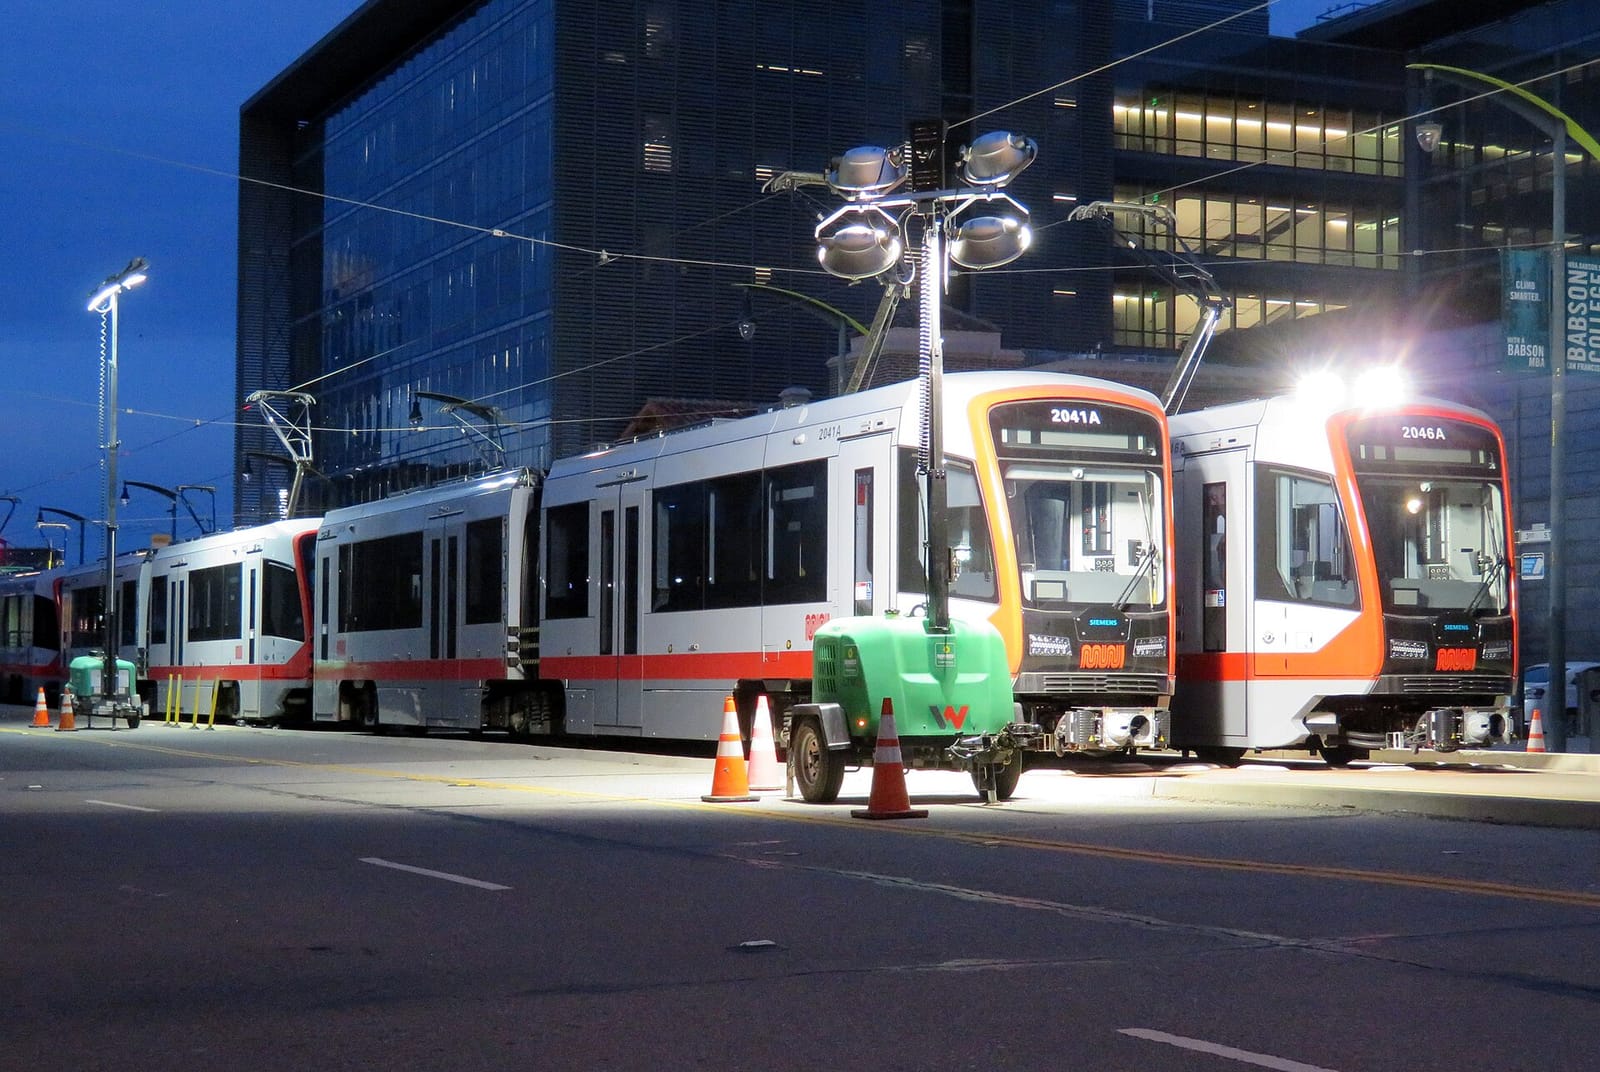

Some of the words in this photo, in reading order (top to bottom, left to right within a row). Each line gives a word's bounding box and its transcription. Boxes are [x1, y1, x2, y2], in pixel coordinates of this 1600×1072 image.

[1567, 270, 1588, 362] BABSON
[1507, 344, 1545, 357] BABSON
[1528, 357, 1545, 368] MBA
[1050, 408, 1101, 425] 2041A
[818, 425, 841, 441] 2041A
[1401, 426, 1446, 441] 2046A
[1089, 618, 1118, 626] SIEMENS
